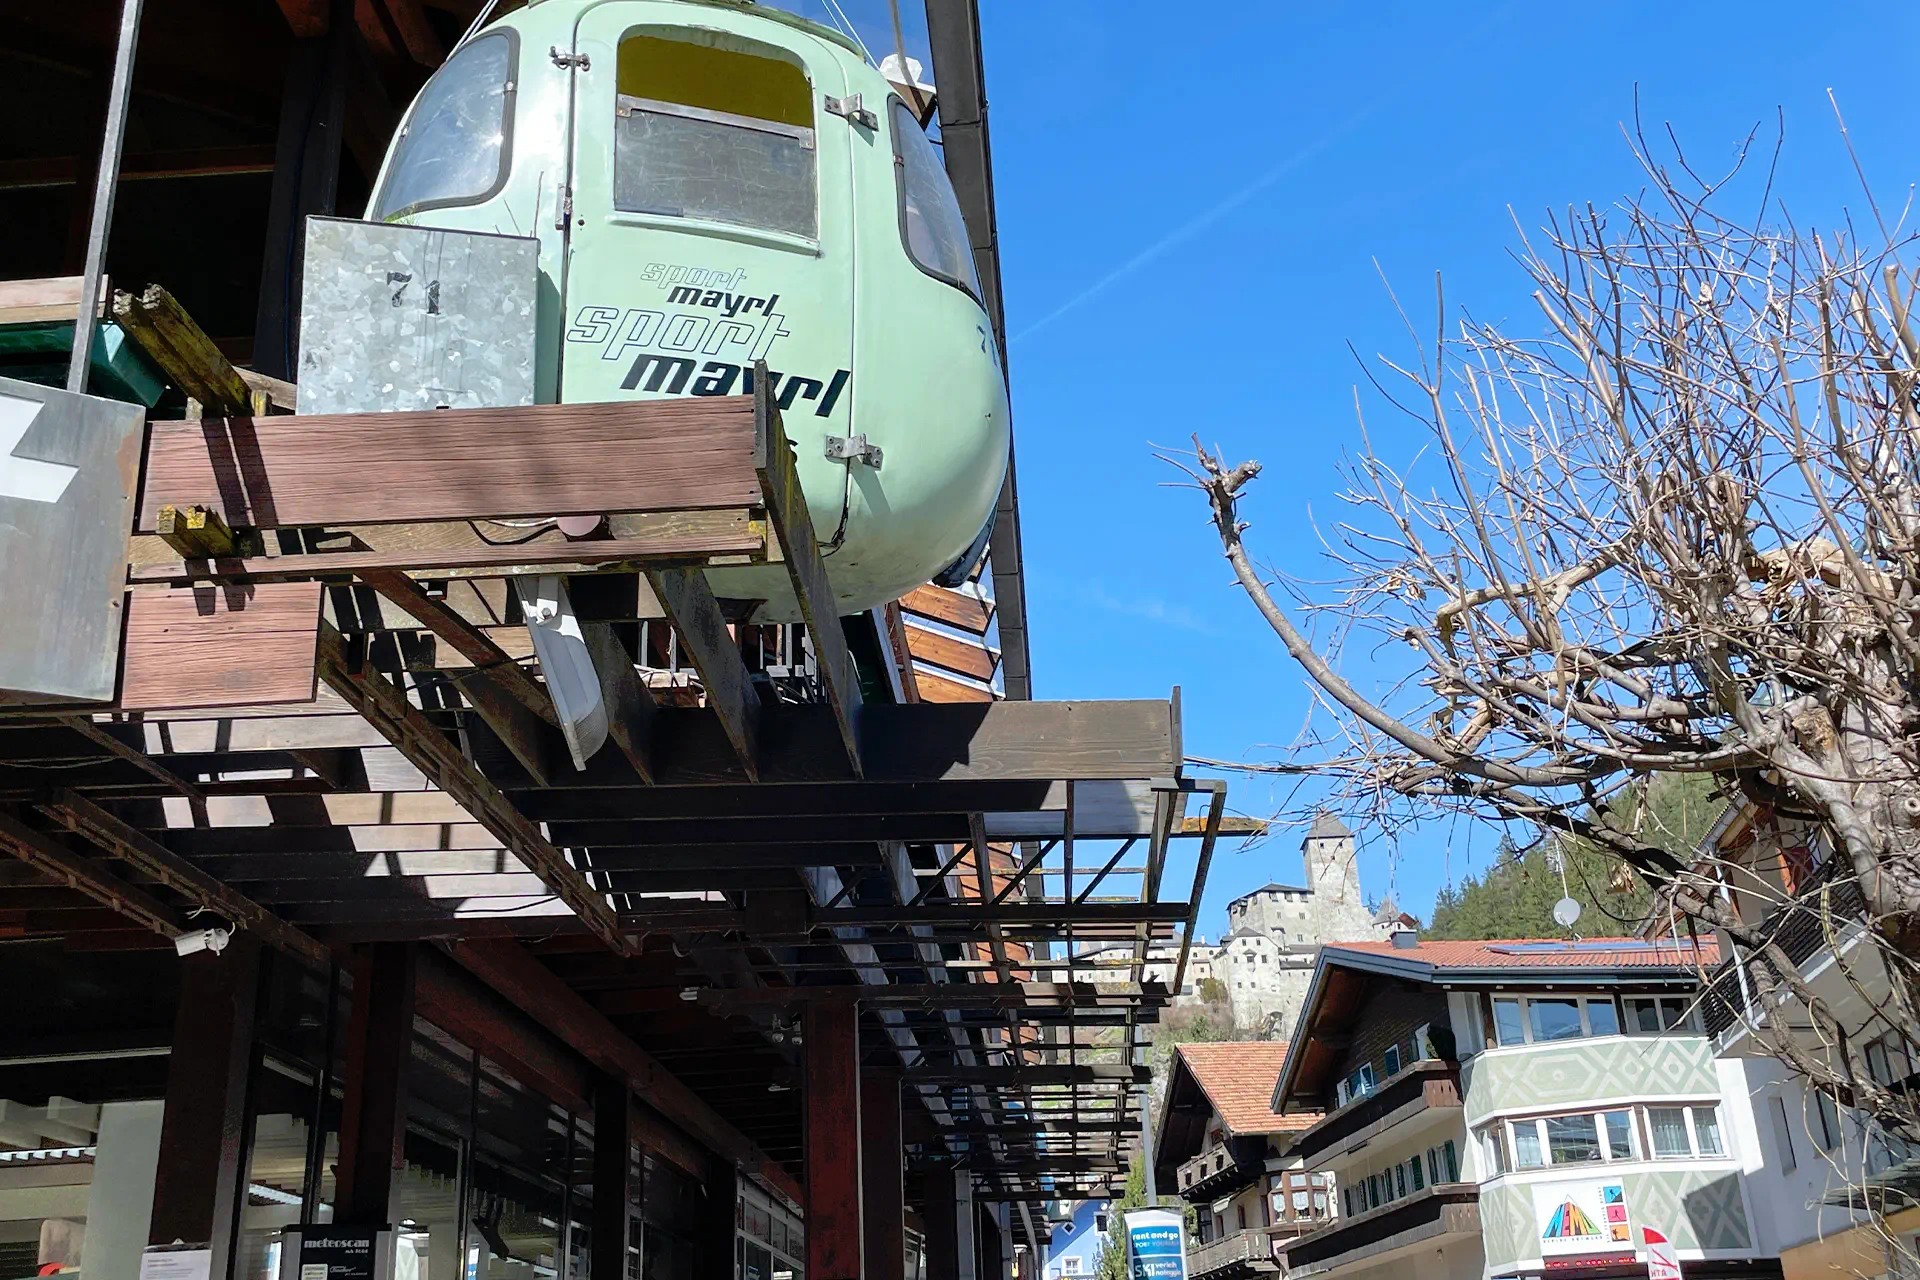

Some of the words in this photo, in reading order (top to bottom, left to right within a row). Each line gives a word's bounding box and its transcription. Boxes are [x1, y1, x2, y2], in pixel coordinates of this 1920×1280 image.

[640, 262, 747, 290] sport
[666, 286, 780, 318] mayrl
[566, 305, 791, 361] sport
[304, 1237, 370, 1249] meteoscan
[1132, 1232, 1150, 1241] rent
[1150, 1231, 1168, 1239] and
[1168, 1232, 1179, 1241] go
[1135, 1263, 1155, 1278] SKI
